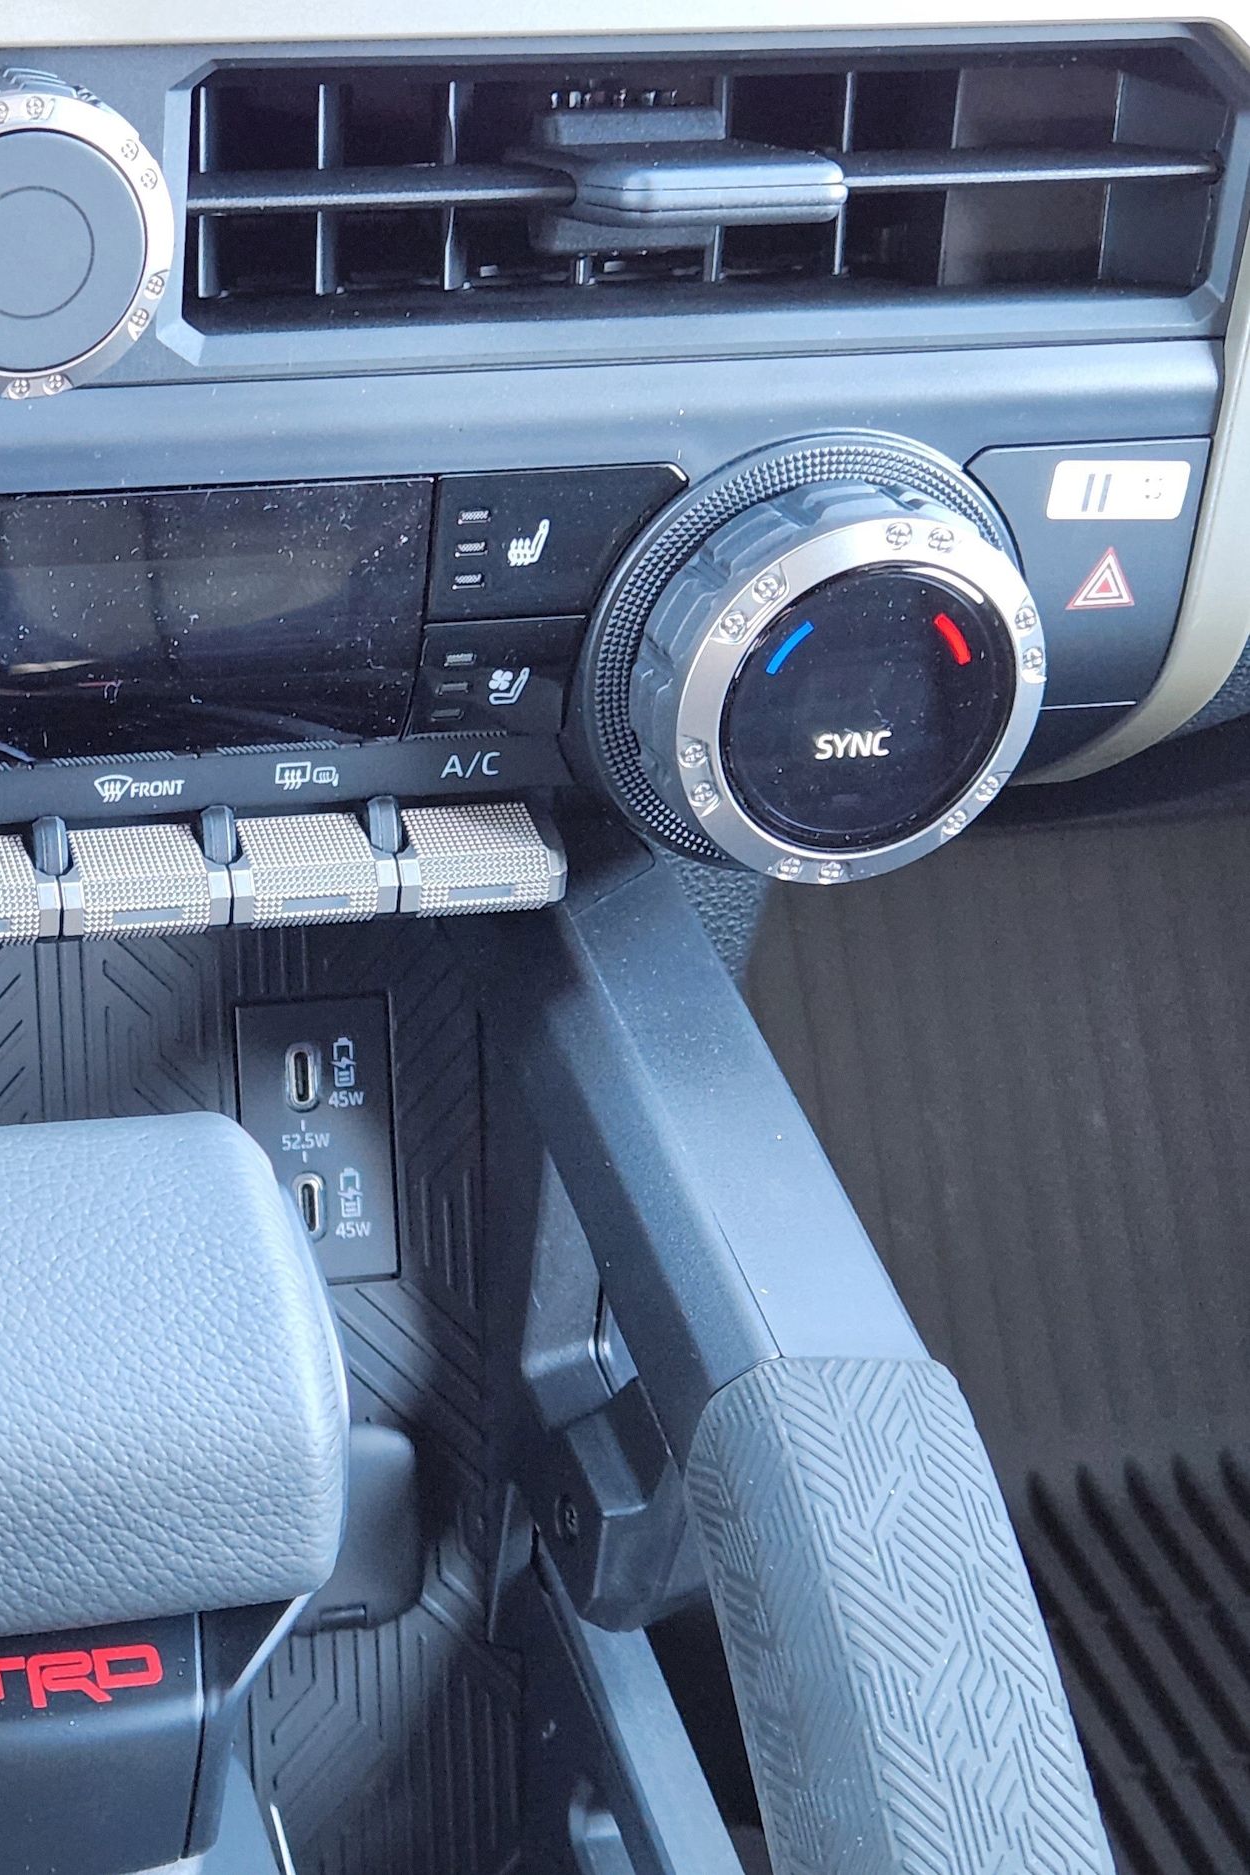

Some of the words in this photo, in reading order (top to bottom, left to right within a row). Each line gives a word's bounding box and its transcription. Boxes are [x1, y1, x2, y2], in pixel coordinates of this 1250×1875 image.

[814, 730, 892, 760] SYNC
[441, 750, 501, 779] A/C
[131, 778, 185, 798] FRONT
[328, 1090, 364, 1108] 45W
[282, 1132, 330, 1151] 52.5W
[335, 1221, 372, 1238] 45W
